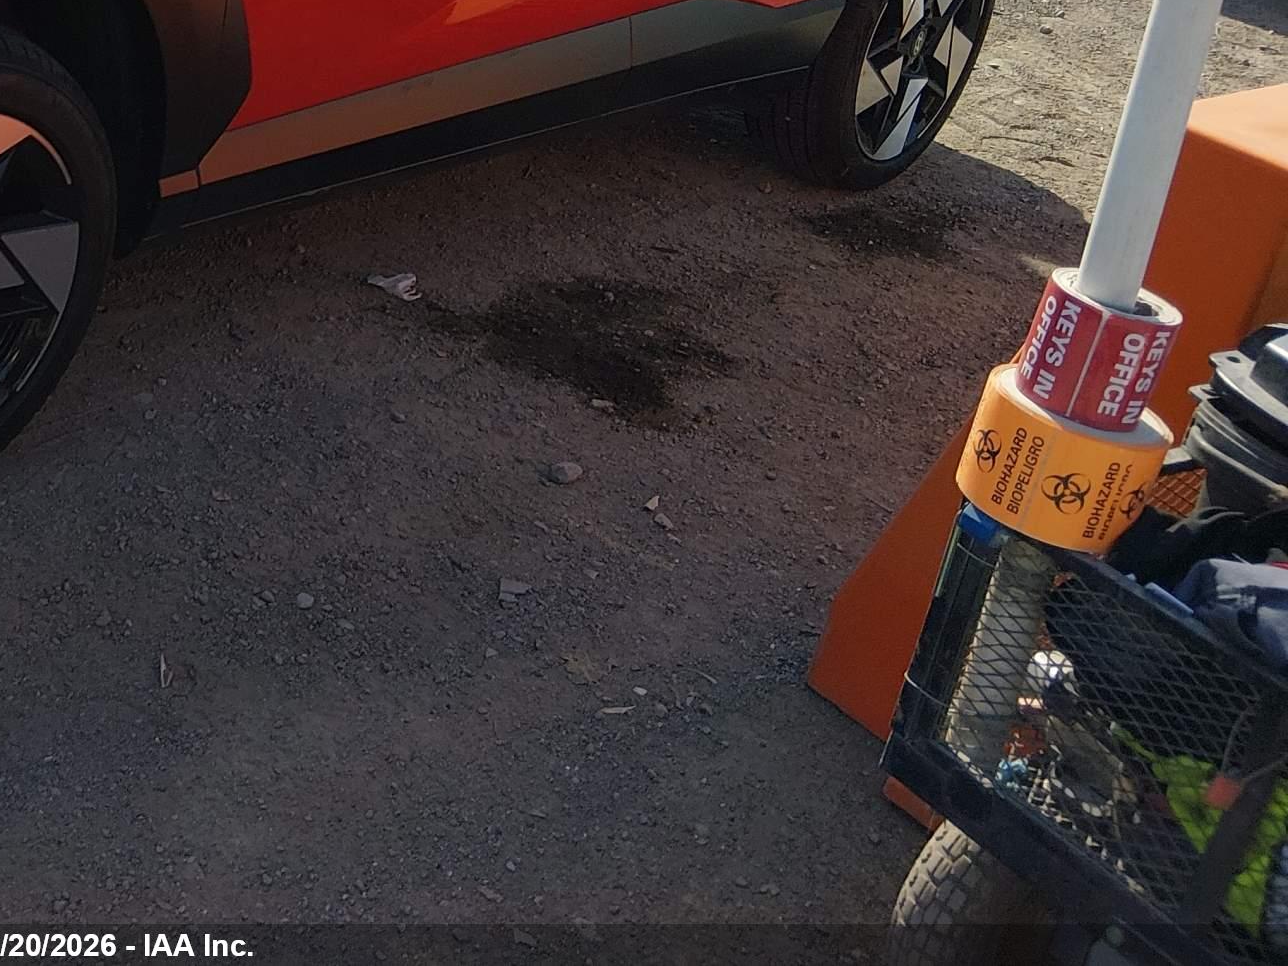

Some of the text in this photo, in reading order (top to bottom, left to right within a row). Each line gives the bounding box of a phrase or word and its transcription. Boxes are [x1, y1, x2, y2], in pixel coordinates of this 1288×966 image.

[1019, 295, 1058, 380] OFFICE
[1032, 300, 1082, 400] KEYS IN
[1096, 333, 1146, 417] OFFICE
[1121, 330, 1172, 425] KEYS IN
[990, 427, 1028, 505] BIOHAZARD
[1006, 435, 1046, 515] BIOPELIGRO
[1082, 462, 1121, 539] BIOHAZARD
